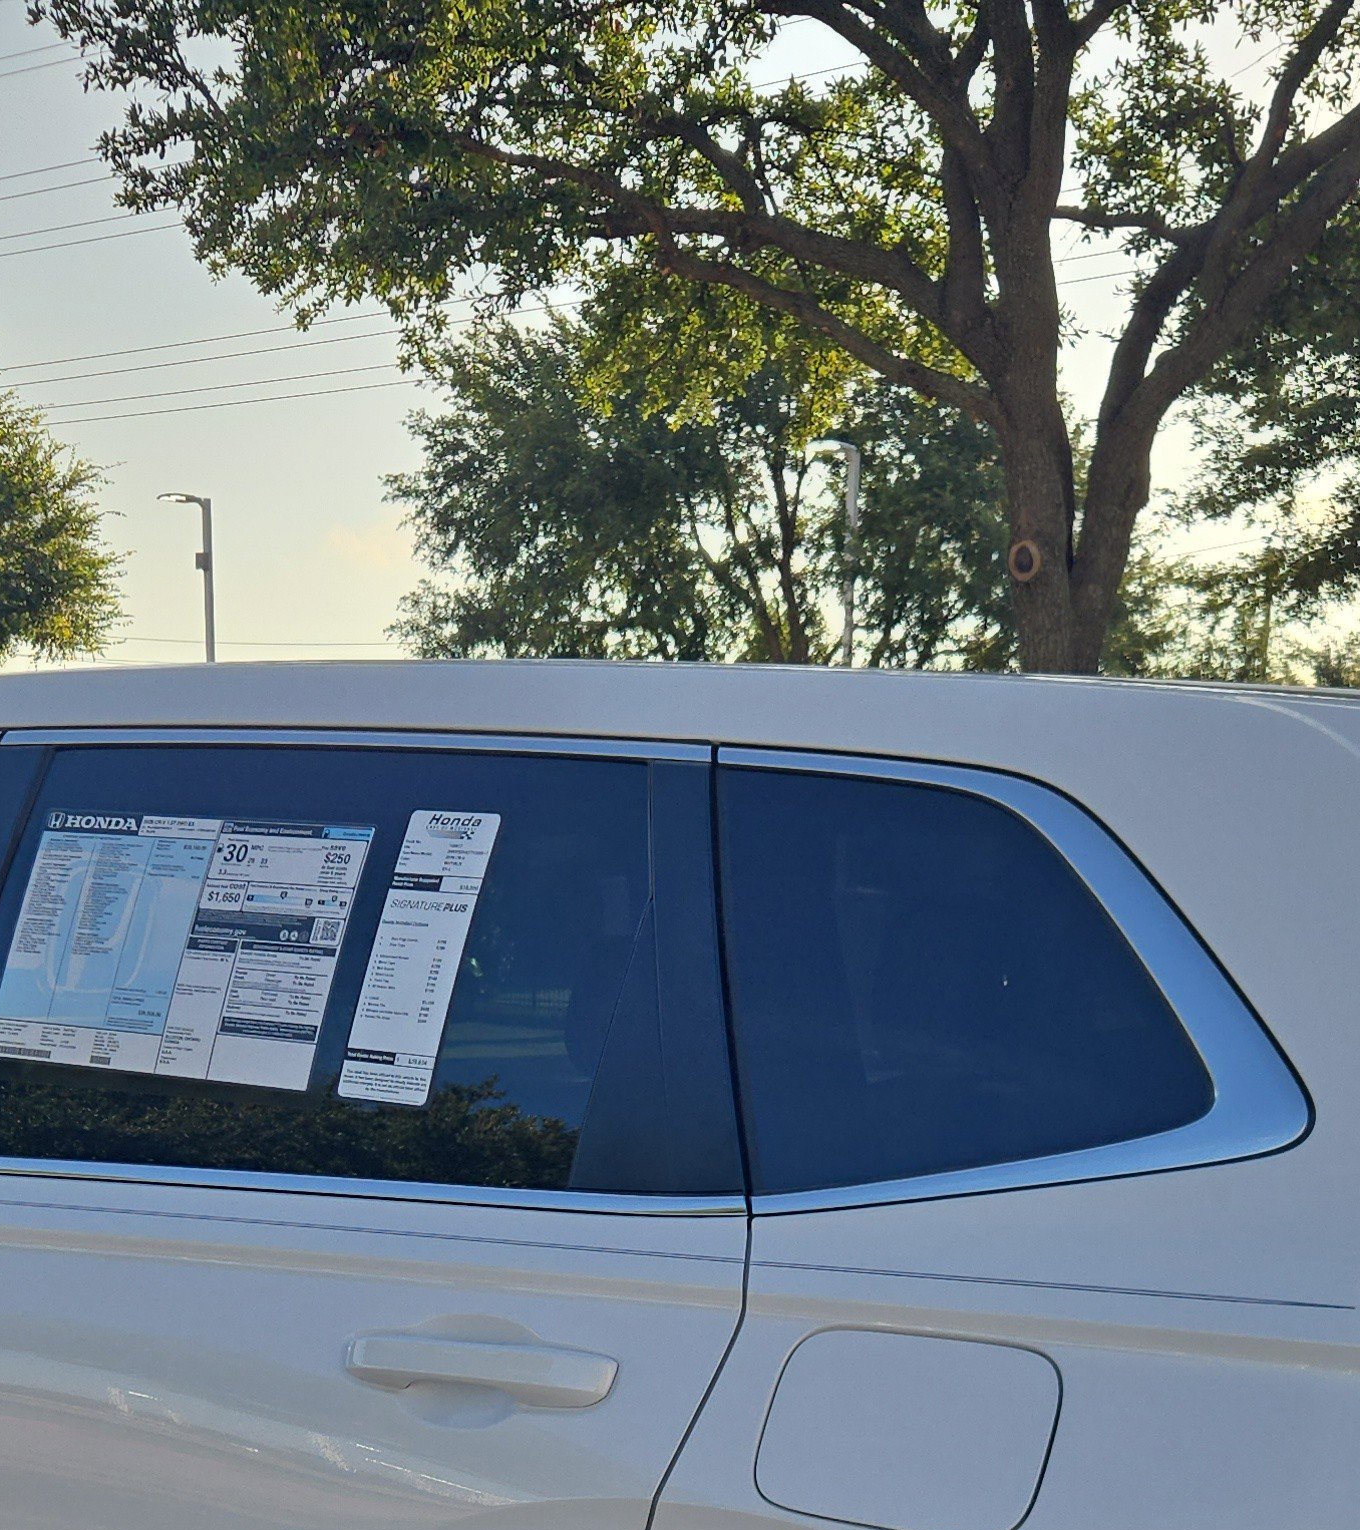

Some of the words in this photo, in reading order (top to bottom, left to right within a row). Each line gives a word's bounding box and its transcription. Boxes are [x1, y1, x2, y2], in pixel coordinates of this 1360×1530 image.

[66, 815, 138, 831] HONDA
[428, 813, 482, 827] Honda
[223, 843, 248, 863] 30
[324, 852, 351, 865] $250
[208, 891, 241, 903] $1,650
